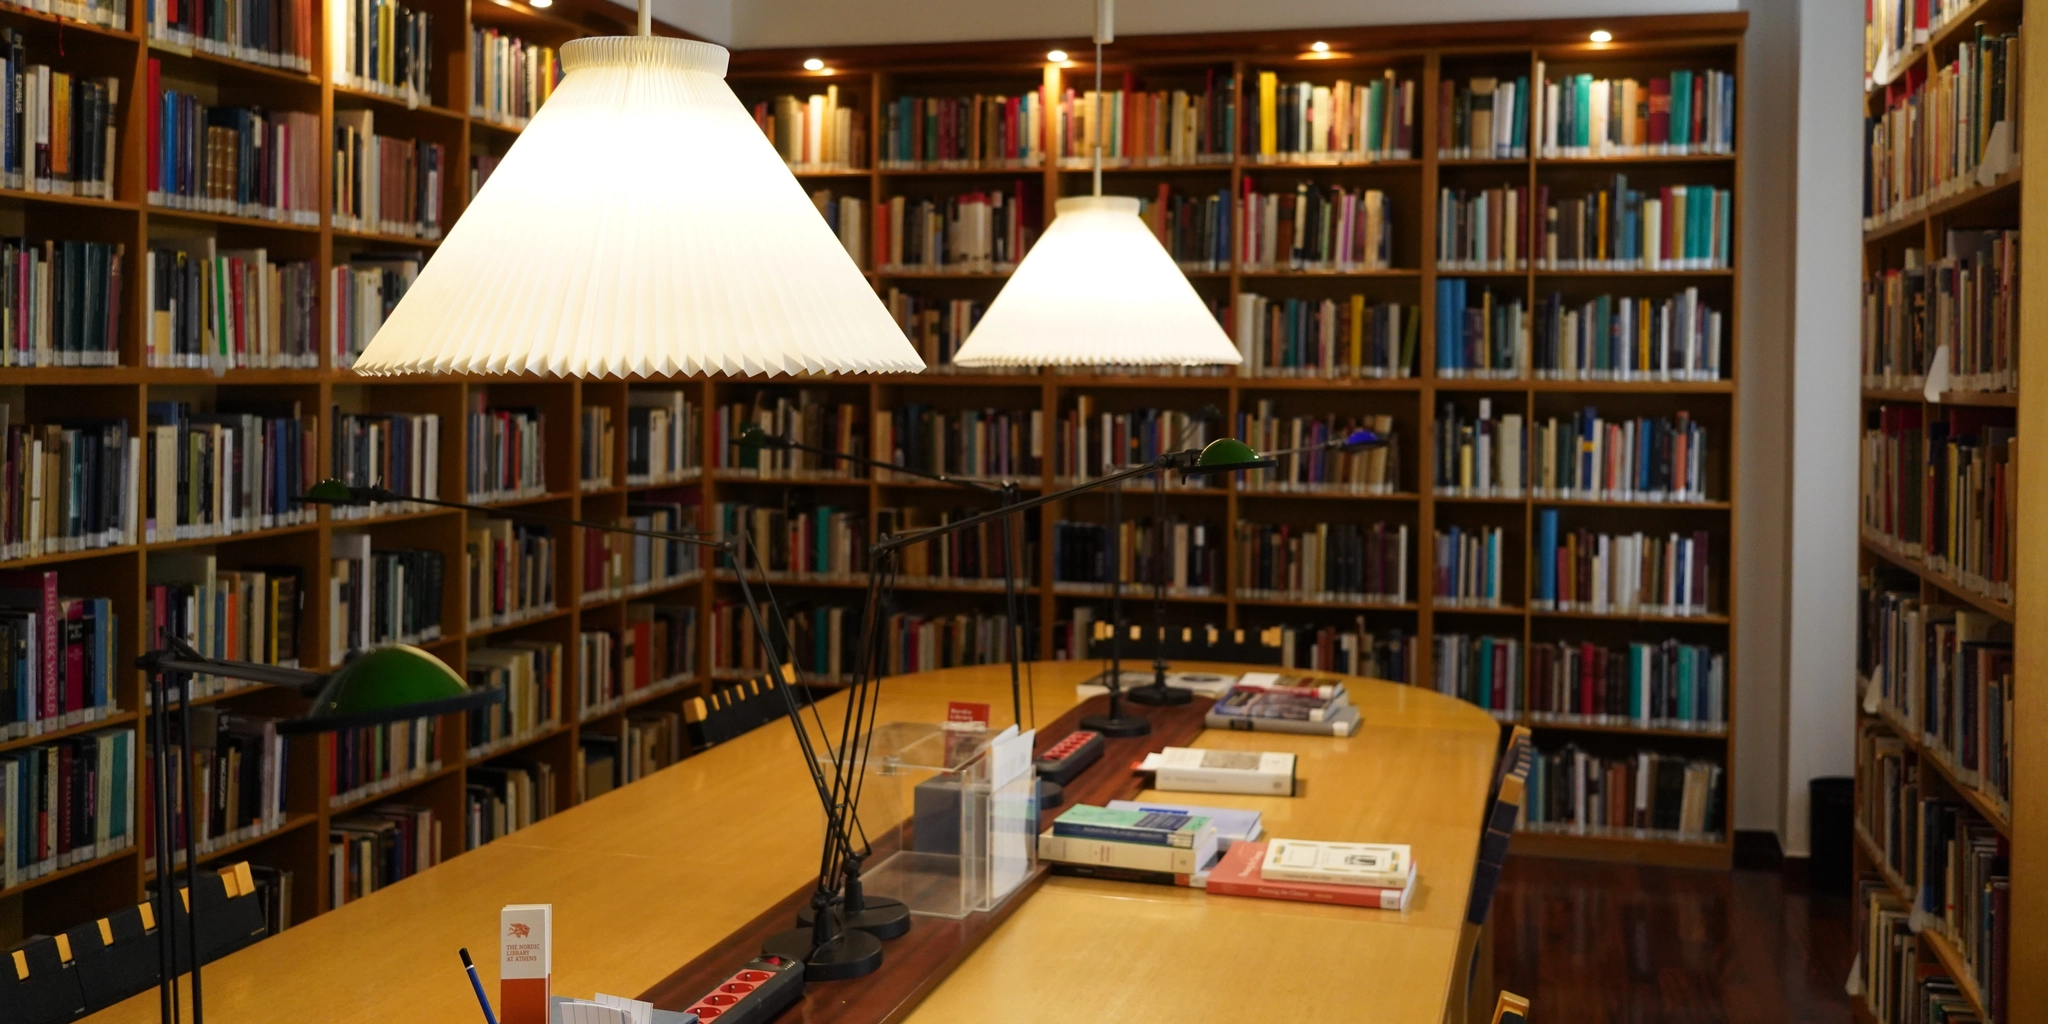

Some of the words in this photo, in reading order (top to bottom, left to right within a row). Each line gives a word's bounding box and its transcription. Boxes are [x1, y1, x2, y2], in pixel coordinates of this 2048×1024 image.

[47, 585, 55, 612] THE
[46, 615, 56, 659] GREEK
[46, 660, 56, 713] WORLD
